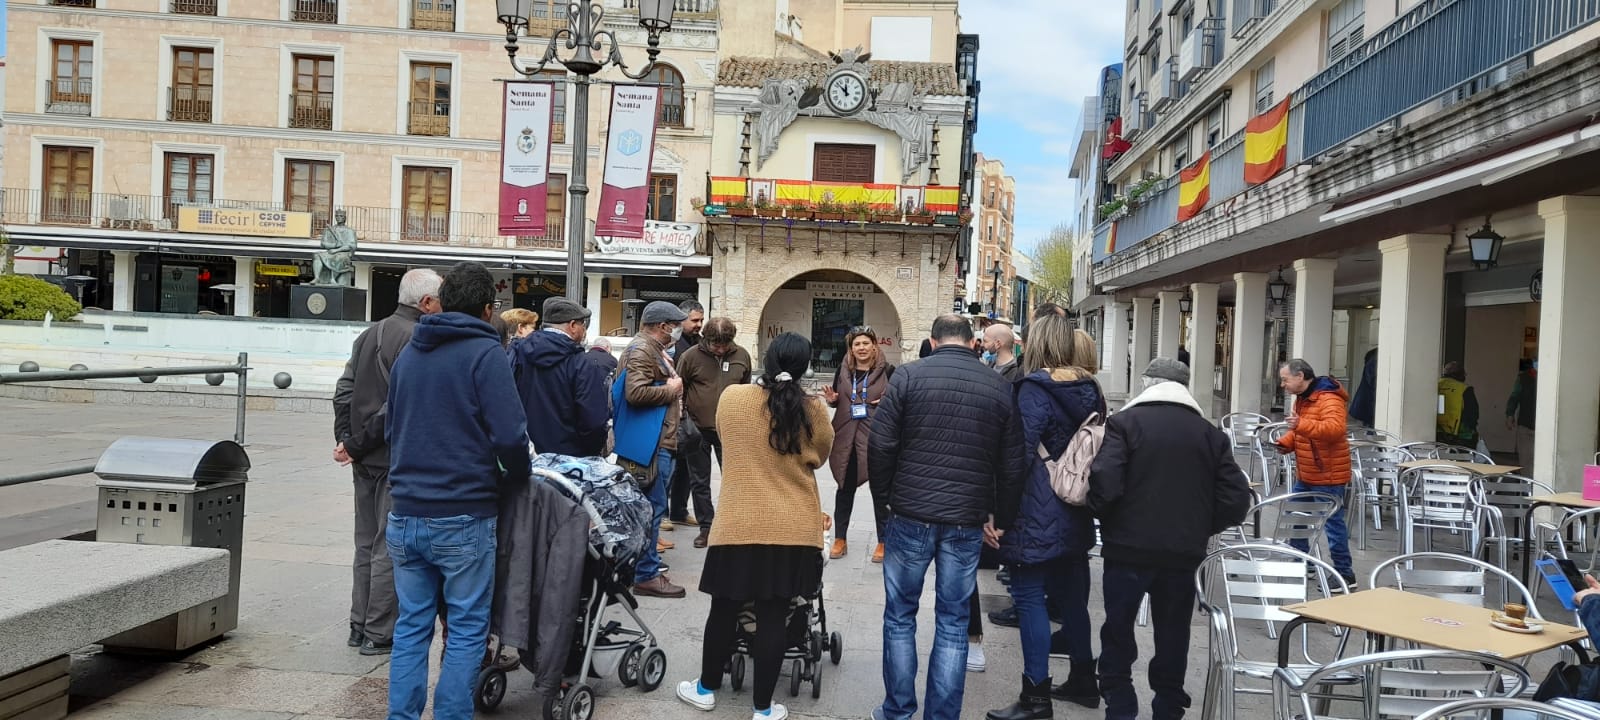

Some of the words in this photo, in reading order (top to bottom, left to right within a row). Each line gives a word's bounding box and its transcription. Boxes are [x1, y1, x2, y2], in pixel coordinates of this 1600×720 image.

[510, 90, 547, 98] Semana
[617, 92, 653, 100] Semana
[510, 99, 536, 107] Santa
[616, 101, 641, 109] Santa
[214, 211, 250, 226] fecir
[660, 232, 692, 246] MATEO
